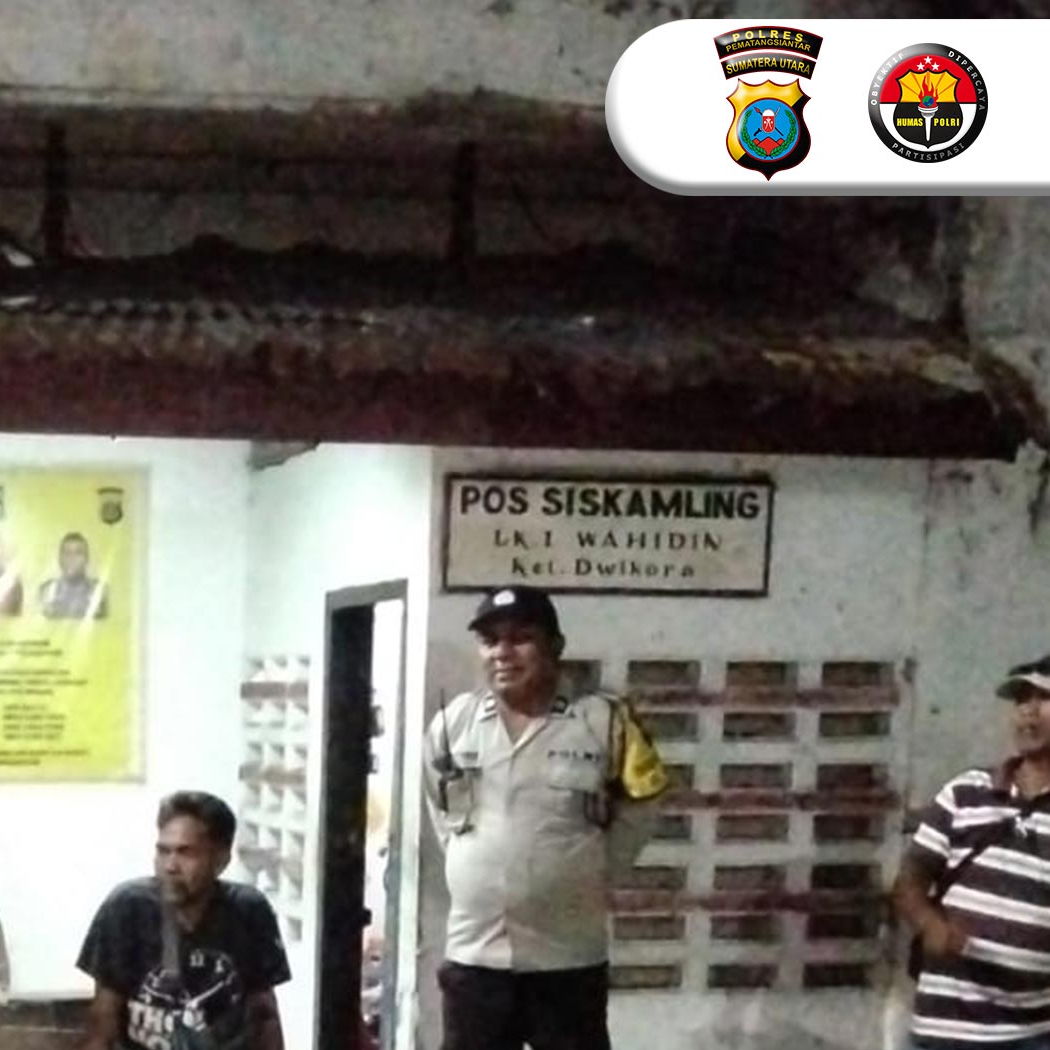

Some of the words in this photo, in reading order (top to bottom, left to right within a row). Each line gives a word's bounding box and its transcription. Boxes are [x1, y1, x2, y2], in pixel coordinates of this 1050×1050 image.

[460, 486, 529, 515] POS
[542, 487, 760, 519] SISKAMLING
[577, 530, 722, 550] WAHIDIN
